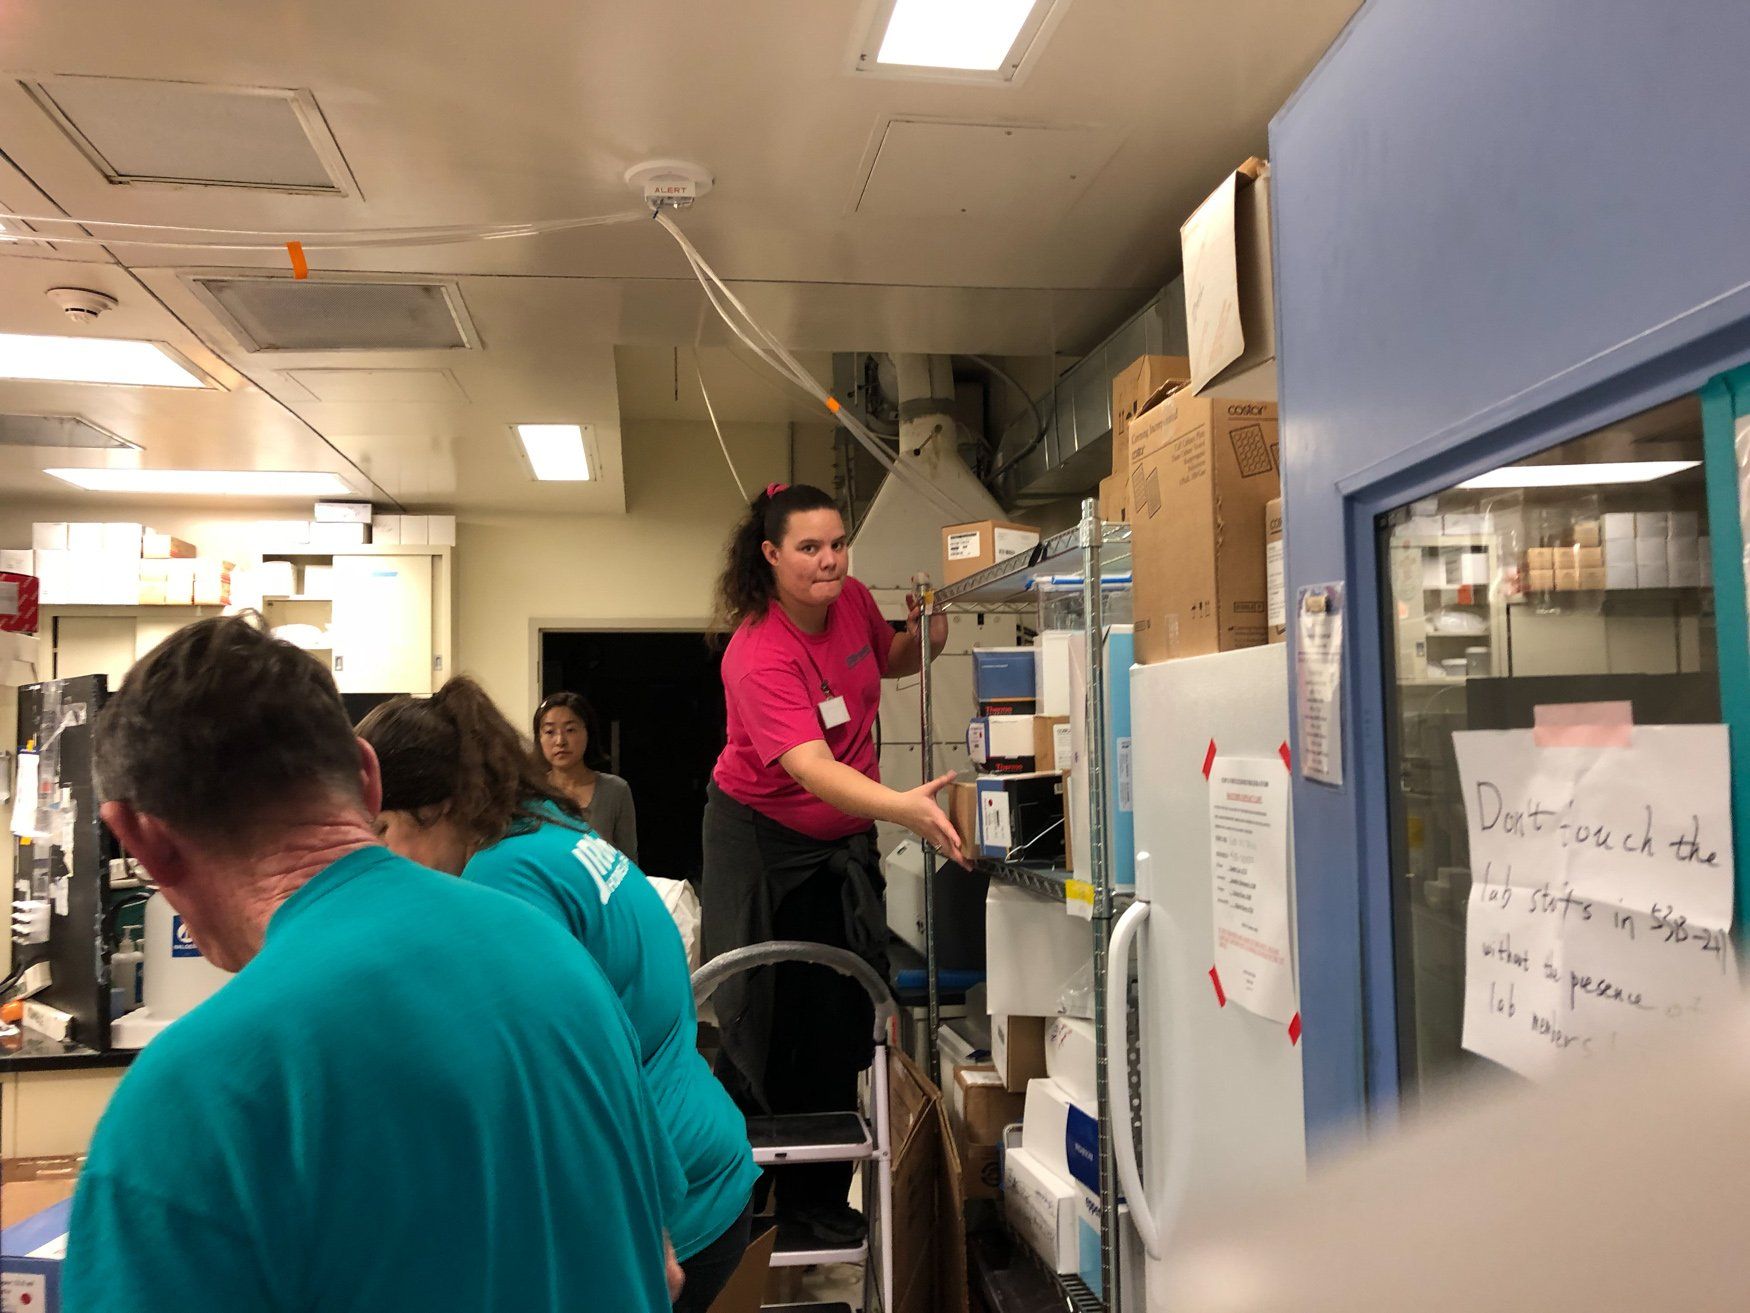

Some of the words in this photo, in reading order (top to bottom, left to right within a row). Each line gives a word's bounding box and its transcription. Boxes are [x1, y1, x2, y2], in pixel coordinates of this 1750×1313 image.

[1477, 782, 1557, 838] Don't
[1560, 799, 1655, 858] touch
[1669, 814, 1721, 867] the
[1482, 862, 1511, 909] lab
[1614, 898, 1636, 940] in
[1489, 982, 1516, 1018] lab
[1570, 970, 1657, 1011] presence
